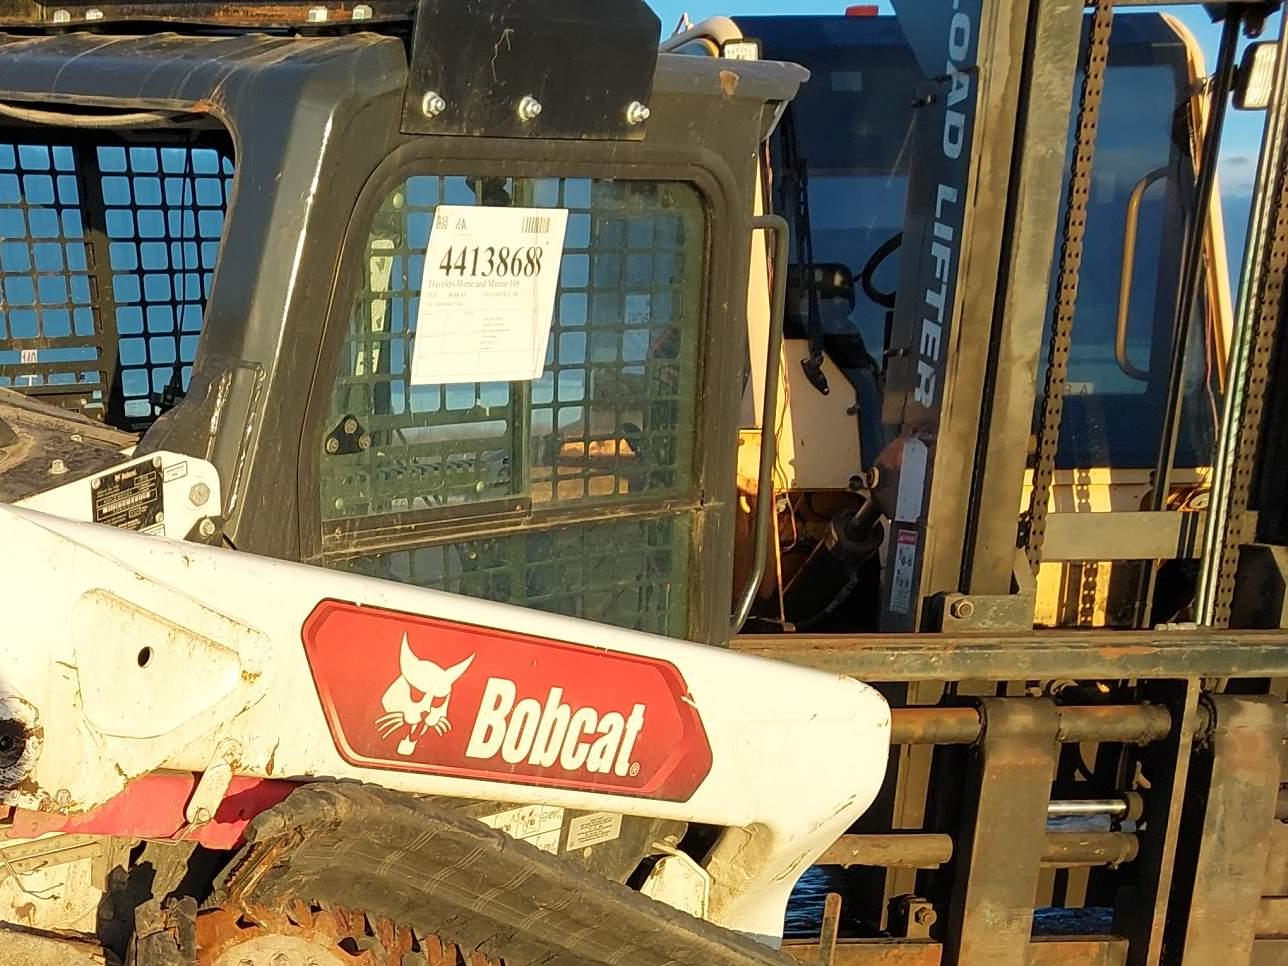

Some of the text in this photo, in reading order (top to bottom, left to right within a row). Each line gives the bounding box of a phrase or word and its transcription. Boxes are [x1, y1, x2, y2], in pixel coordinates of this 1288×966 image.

[913, 0, 970, 409] OAD LIFTER
[465, 677, 647, 777] Bobcat
